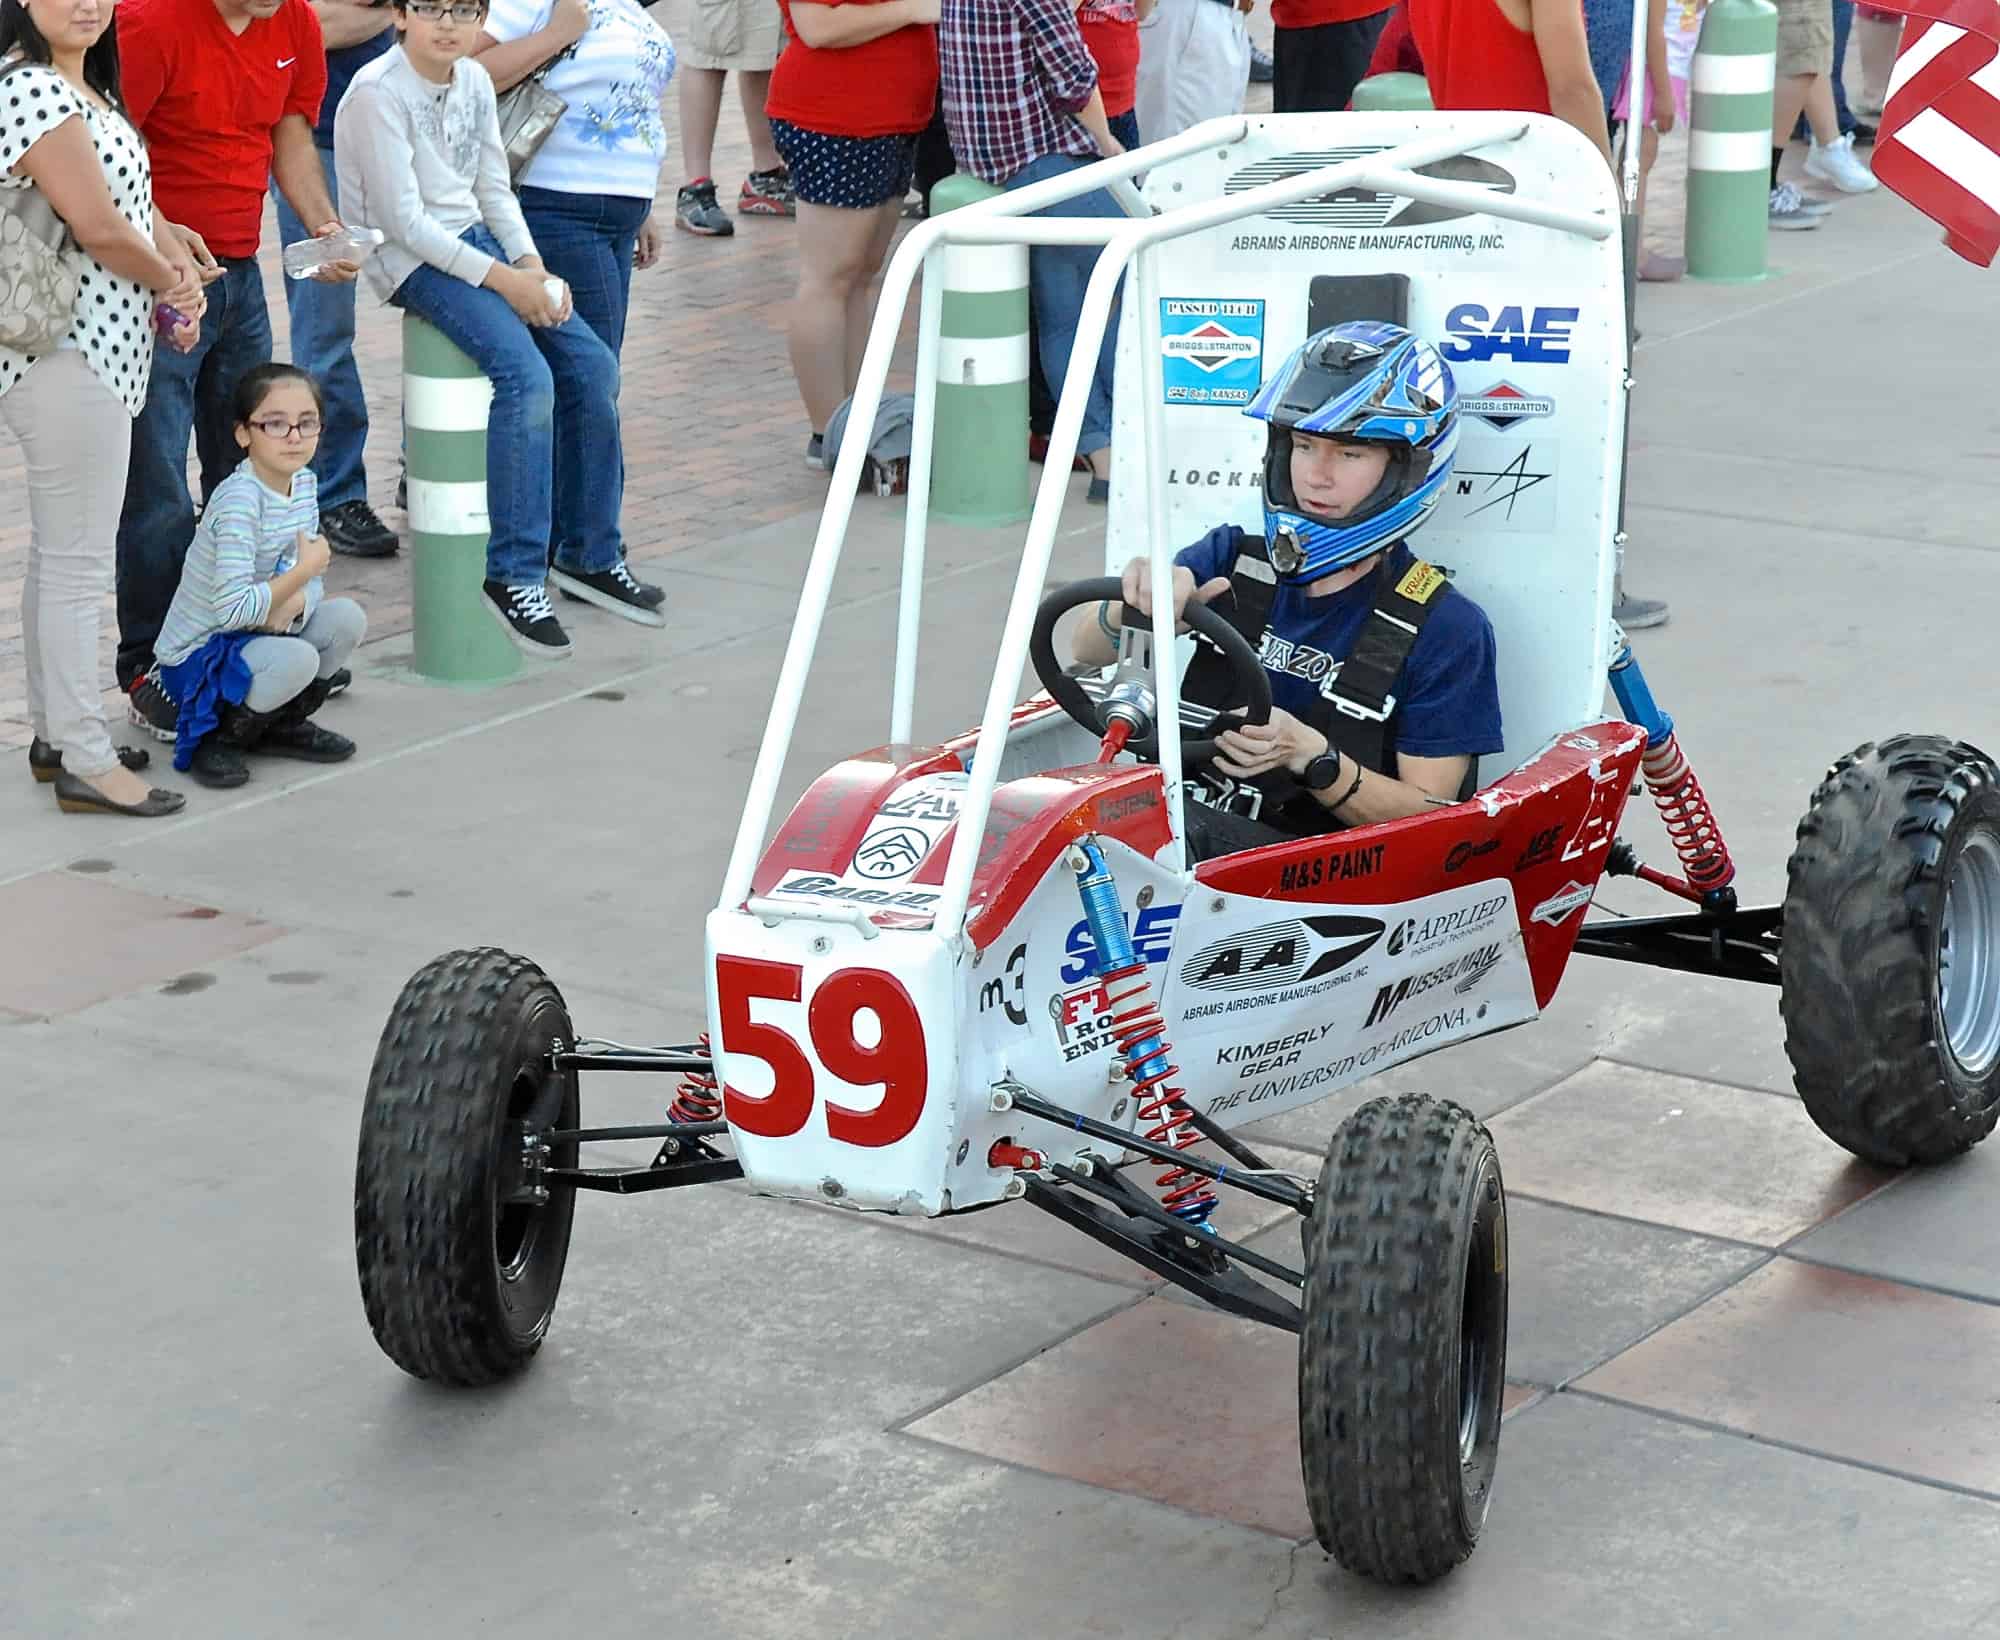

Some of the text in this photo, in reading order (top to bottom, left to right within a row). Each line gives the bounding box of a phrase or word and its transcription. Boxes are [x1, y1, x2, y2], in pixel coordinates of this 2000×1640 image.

[1231, 234, 1505, 252] ABRAMS AIRBORNE MANUFACTURING, INC.
[1168, 302, 1256, 315] PASSED TECH
[1439, 303, 1580, 365] SAE
[1211, 389, 1248, 400] KANSAS
[1167, 468, 1264, 487] LOCKH
[1281, 844, 1386, 892] M&S PAINT
[1413, 895, 1508, 945] APPLIED
[1060, 903, 1183, 985] SE
[1183, 1001, 1224, 1022] ABRAMS
[1226, 992, 1278, 1013] AIRBORNE
[1074, 1014, 1114, 1040] RO
[1216, 1022, 1335, 1065] KIMBERLY
[716, 952, 929, 1148] 59
[1239, 1050, 1302, 1079] GEAR
[1206, 1089, 1246, 1116] THE
[1248, 1052, 1357, 1103] UNIVERSITY
[1358, 1037, 1390, 1068] OF
